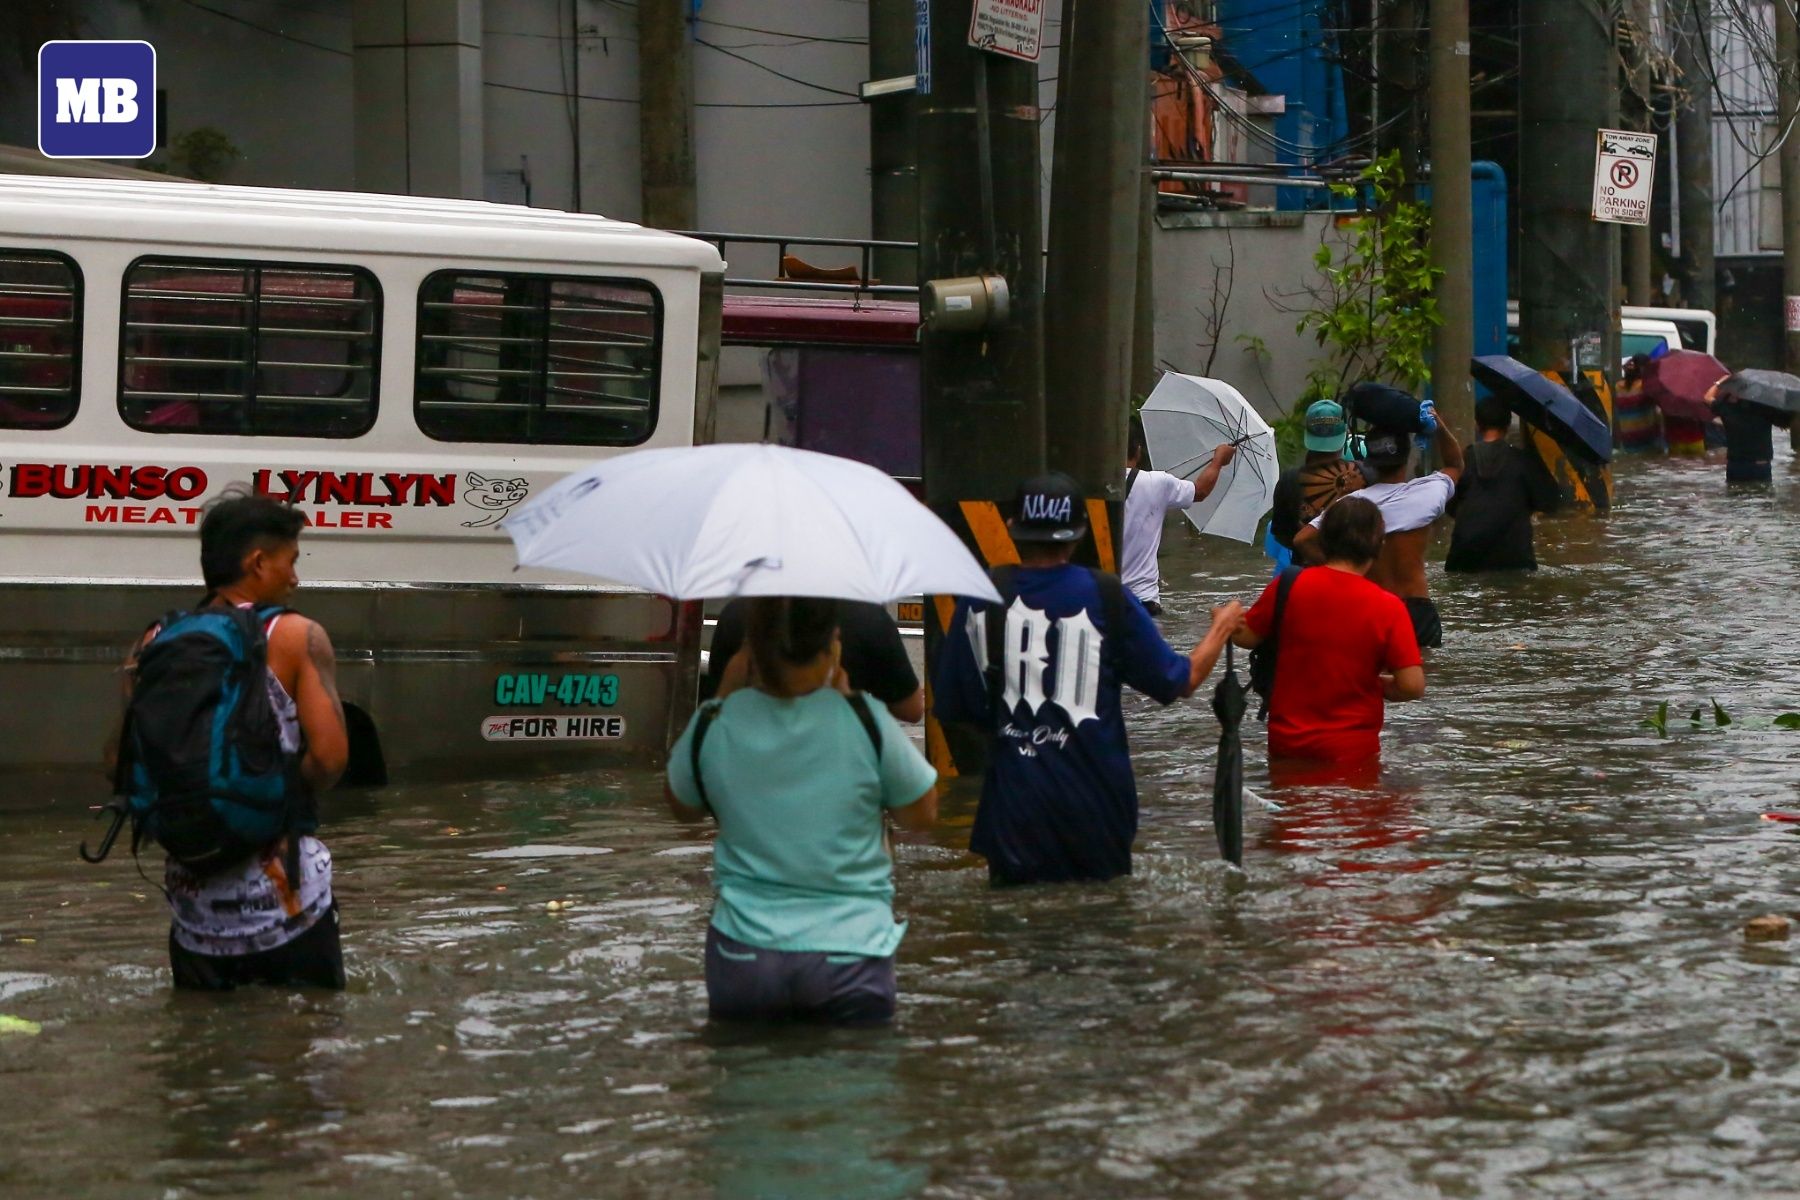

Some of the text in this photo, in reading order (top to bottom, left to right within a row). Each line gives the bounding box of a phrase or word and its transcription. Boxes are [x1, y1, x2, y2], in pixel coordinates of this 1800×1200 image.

[1619, 135, 1634, 143] AWAY
[1600, 186, 1615, 196] NO
[1600, 196, 1647, 210] PARKING
[8, 463, 208, 501] BUNSO
[253, 469, 457, 507] LYNLYN
[85, 505, 206, 525] MEAT
[495, 672, 620, 706] CAV-4743
[509, 718, 557, 737] FOR
[566, 717, 621, 737] HIRE
